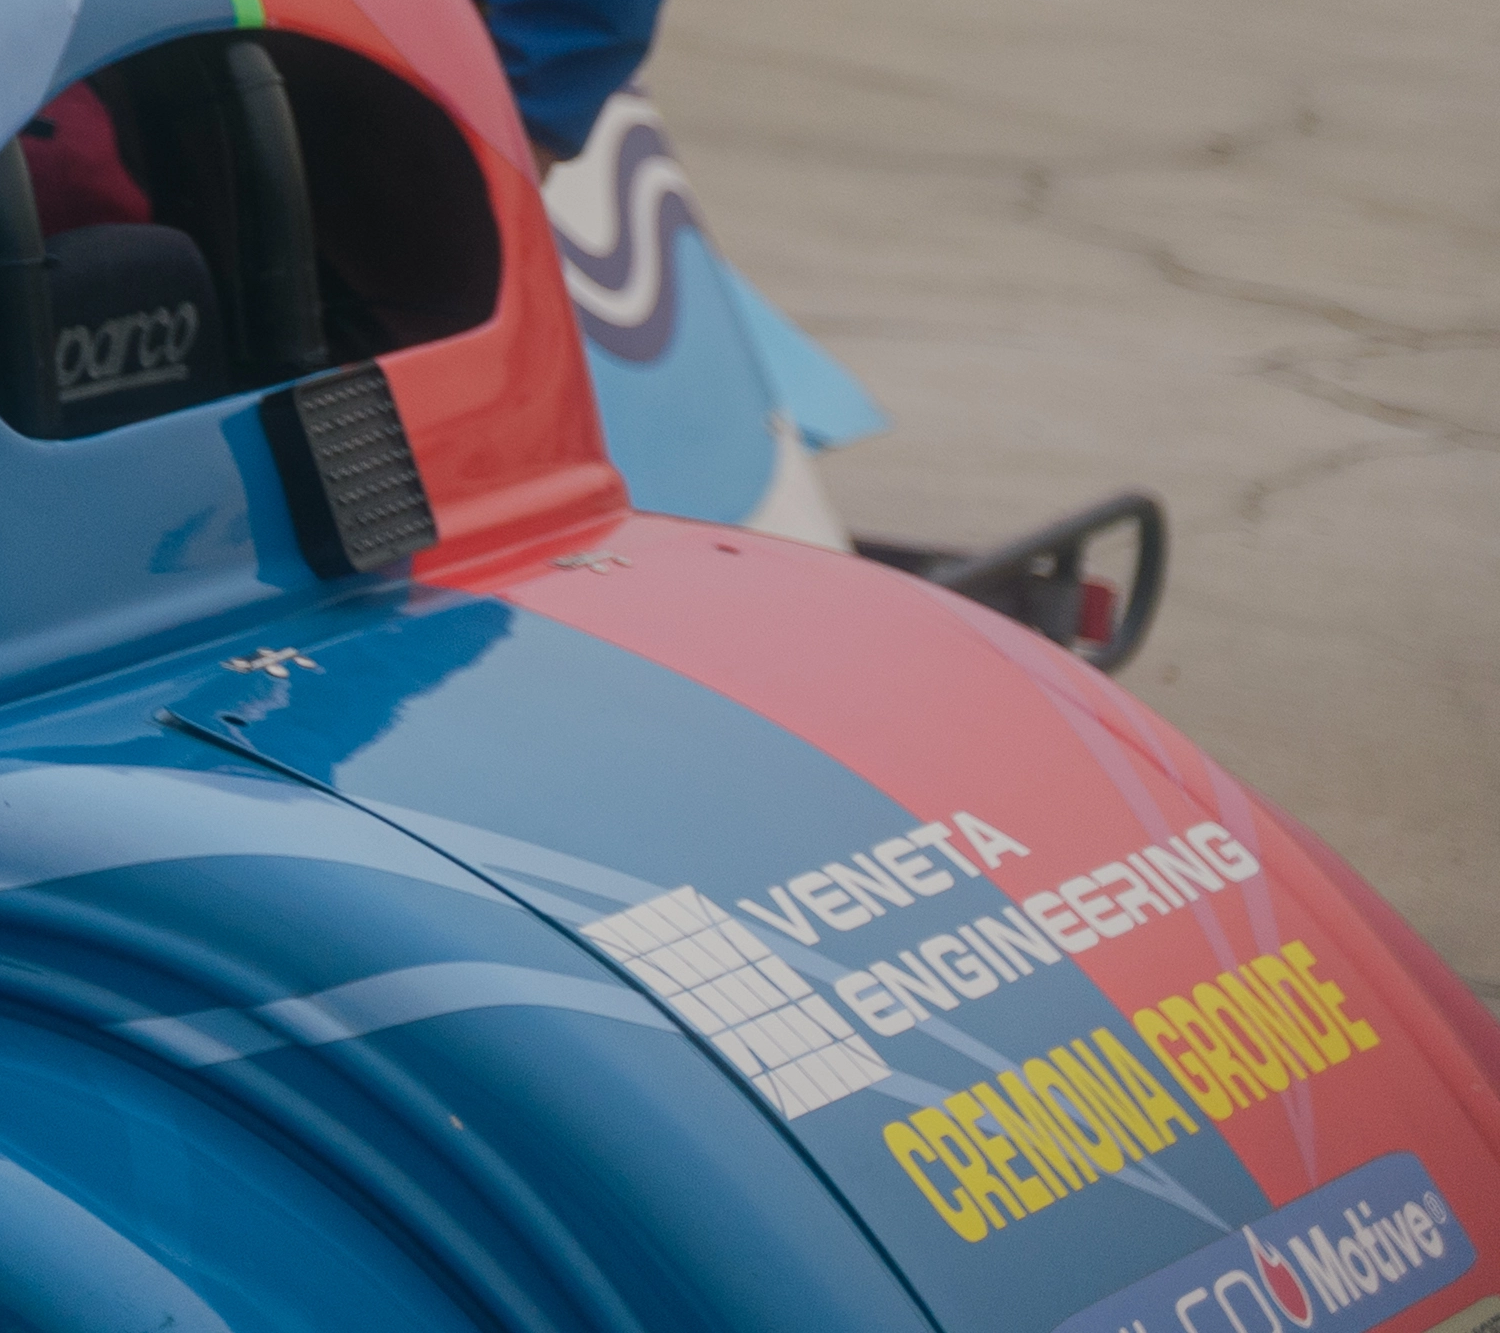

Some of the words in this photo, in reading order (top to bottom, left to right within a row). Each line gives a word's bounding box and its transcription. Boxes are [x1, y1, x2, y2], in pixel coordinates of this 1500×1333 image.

[53, 301, 200, 386] parco
[737, 810, 1031, 948] VENETA
[835, 819, 1260, 1038] ENGINEERING
[882, 1027, 1199, 1244] CREMONA
[1130, 939, 1380, 1121] GRONDE
